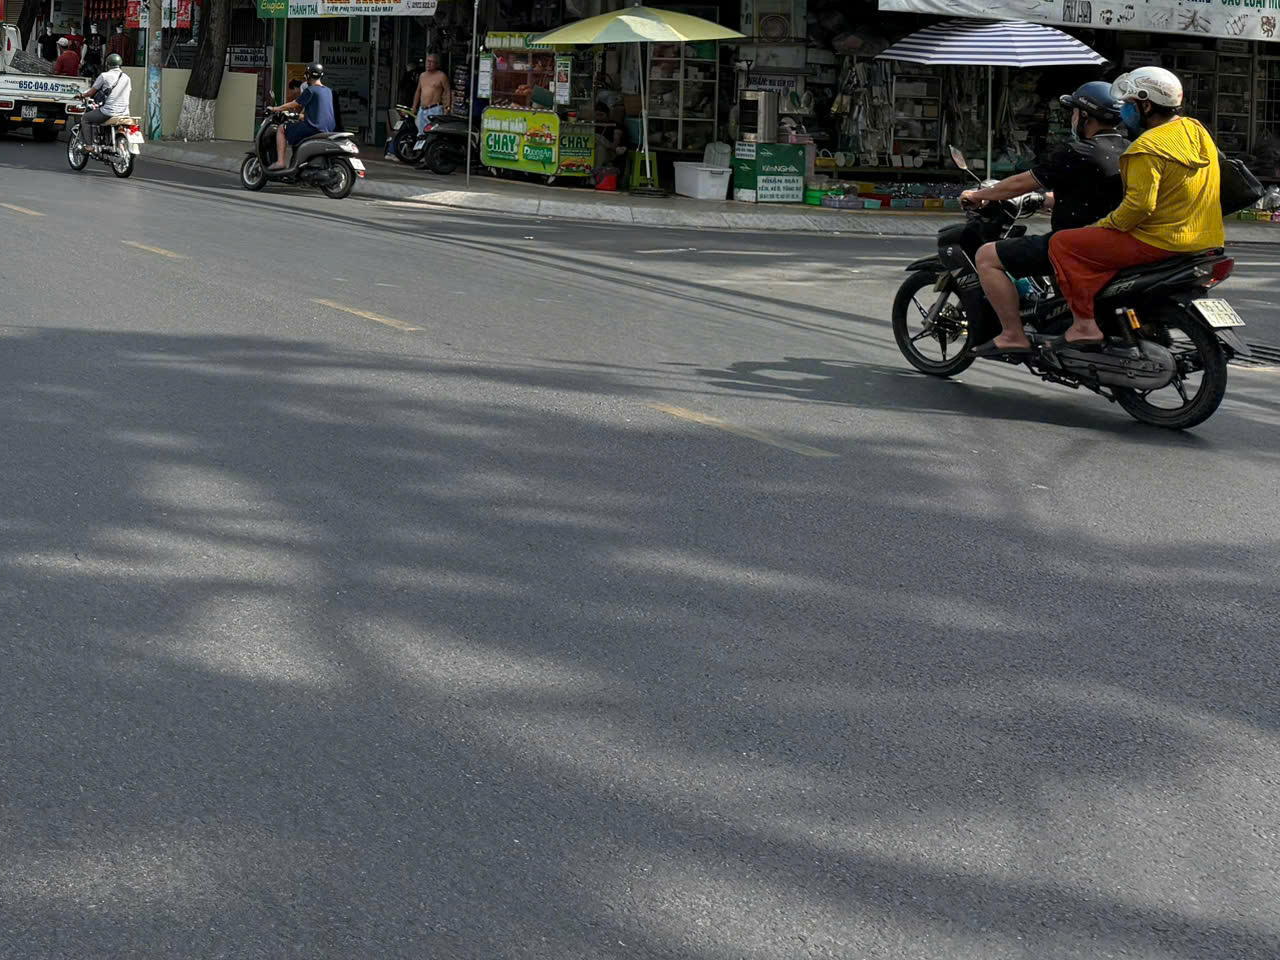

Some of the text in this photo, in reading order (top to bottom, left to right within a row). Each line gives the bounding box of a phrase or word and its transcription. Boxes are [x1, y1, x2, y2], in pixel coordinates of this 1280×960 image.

[289, 2, 307, 15] THÀNH
[486, 132, 517, 153] CHAY
[560, 135, 590, 149] CHAY
